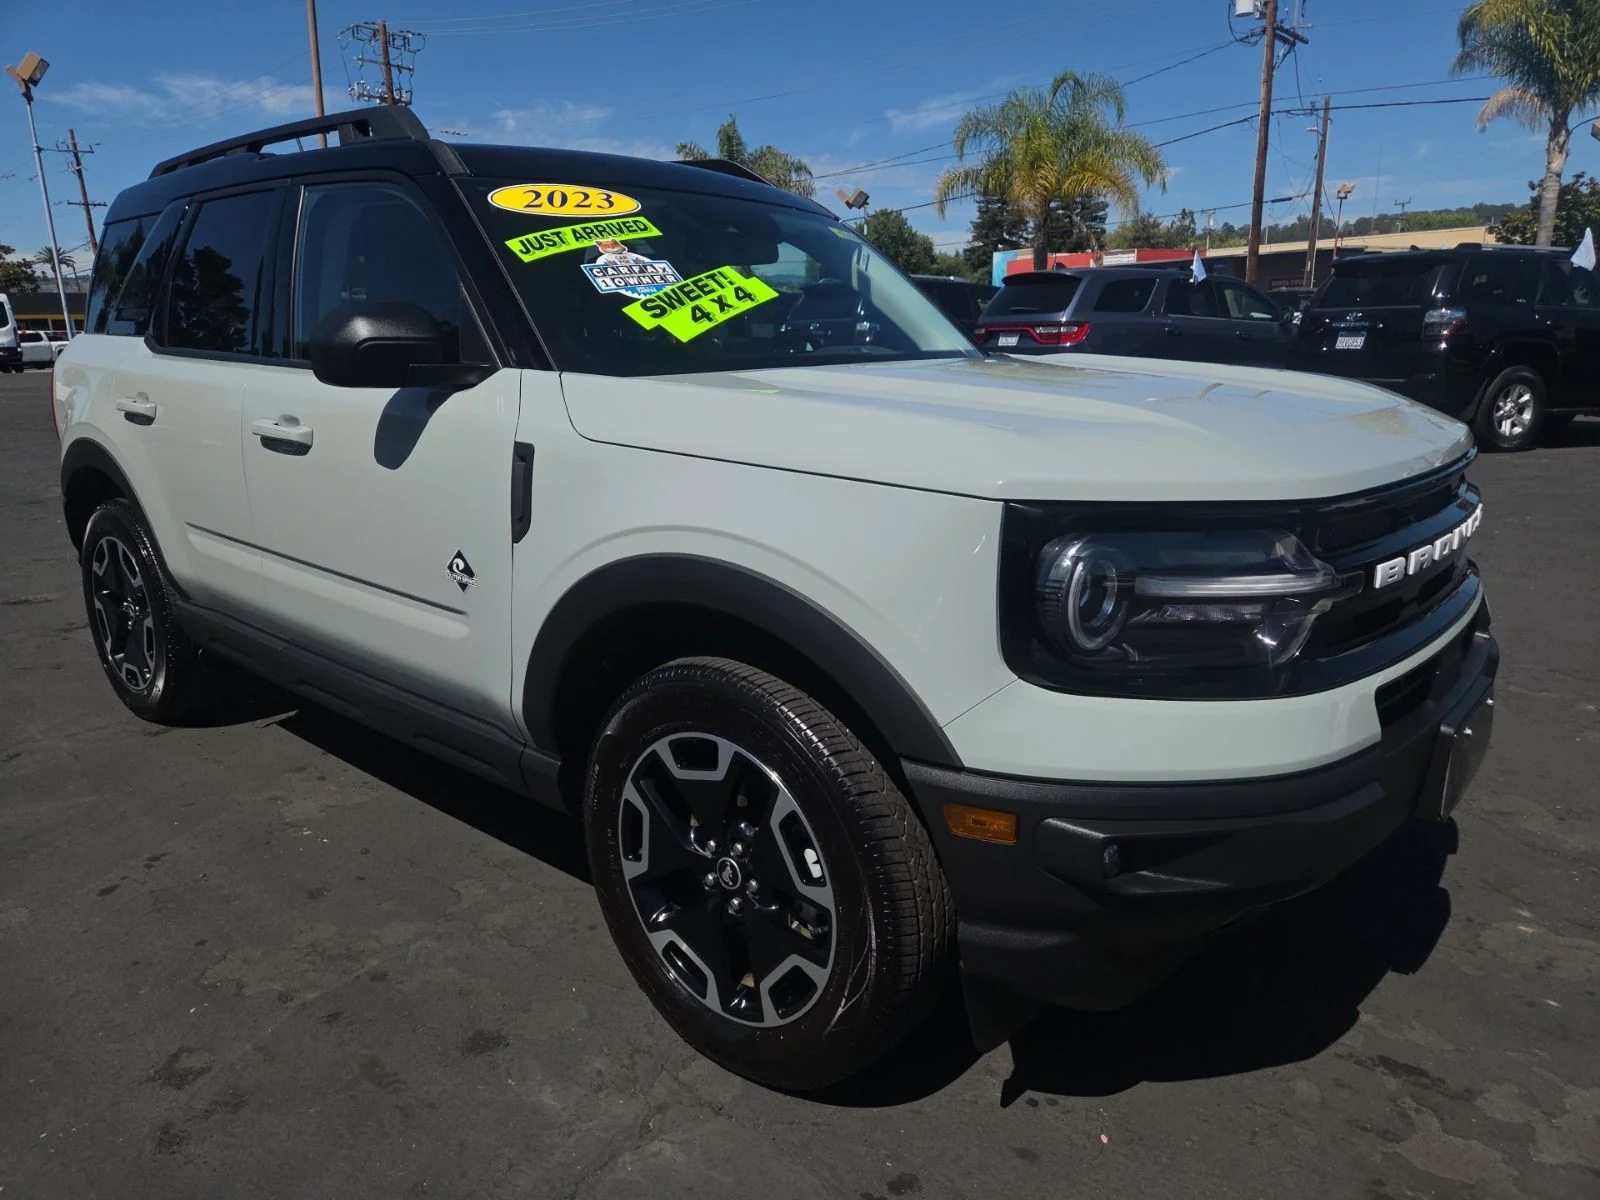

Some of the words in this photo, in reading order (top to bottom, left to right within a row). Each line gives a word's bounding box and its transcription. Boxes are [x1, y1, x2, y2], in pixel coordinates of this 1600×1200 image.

[523, 189, 615, 209] 2023
[519, 231, 567, 255] JUST
[571, 219, 650, 242] ARRIVED
[592, 265, 672, 277] CARFAX
[640, 270, 735, 319] SWEET!
